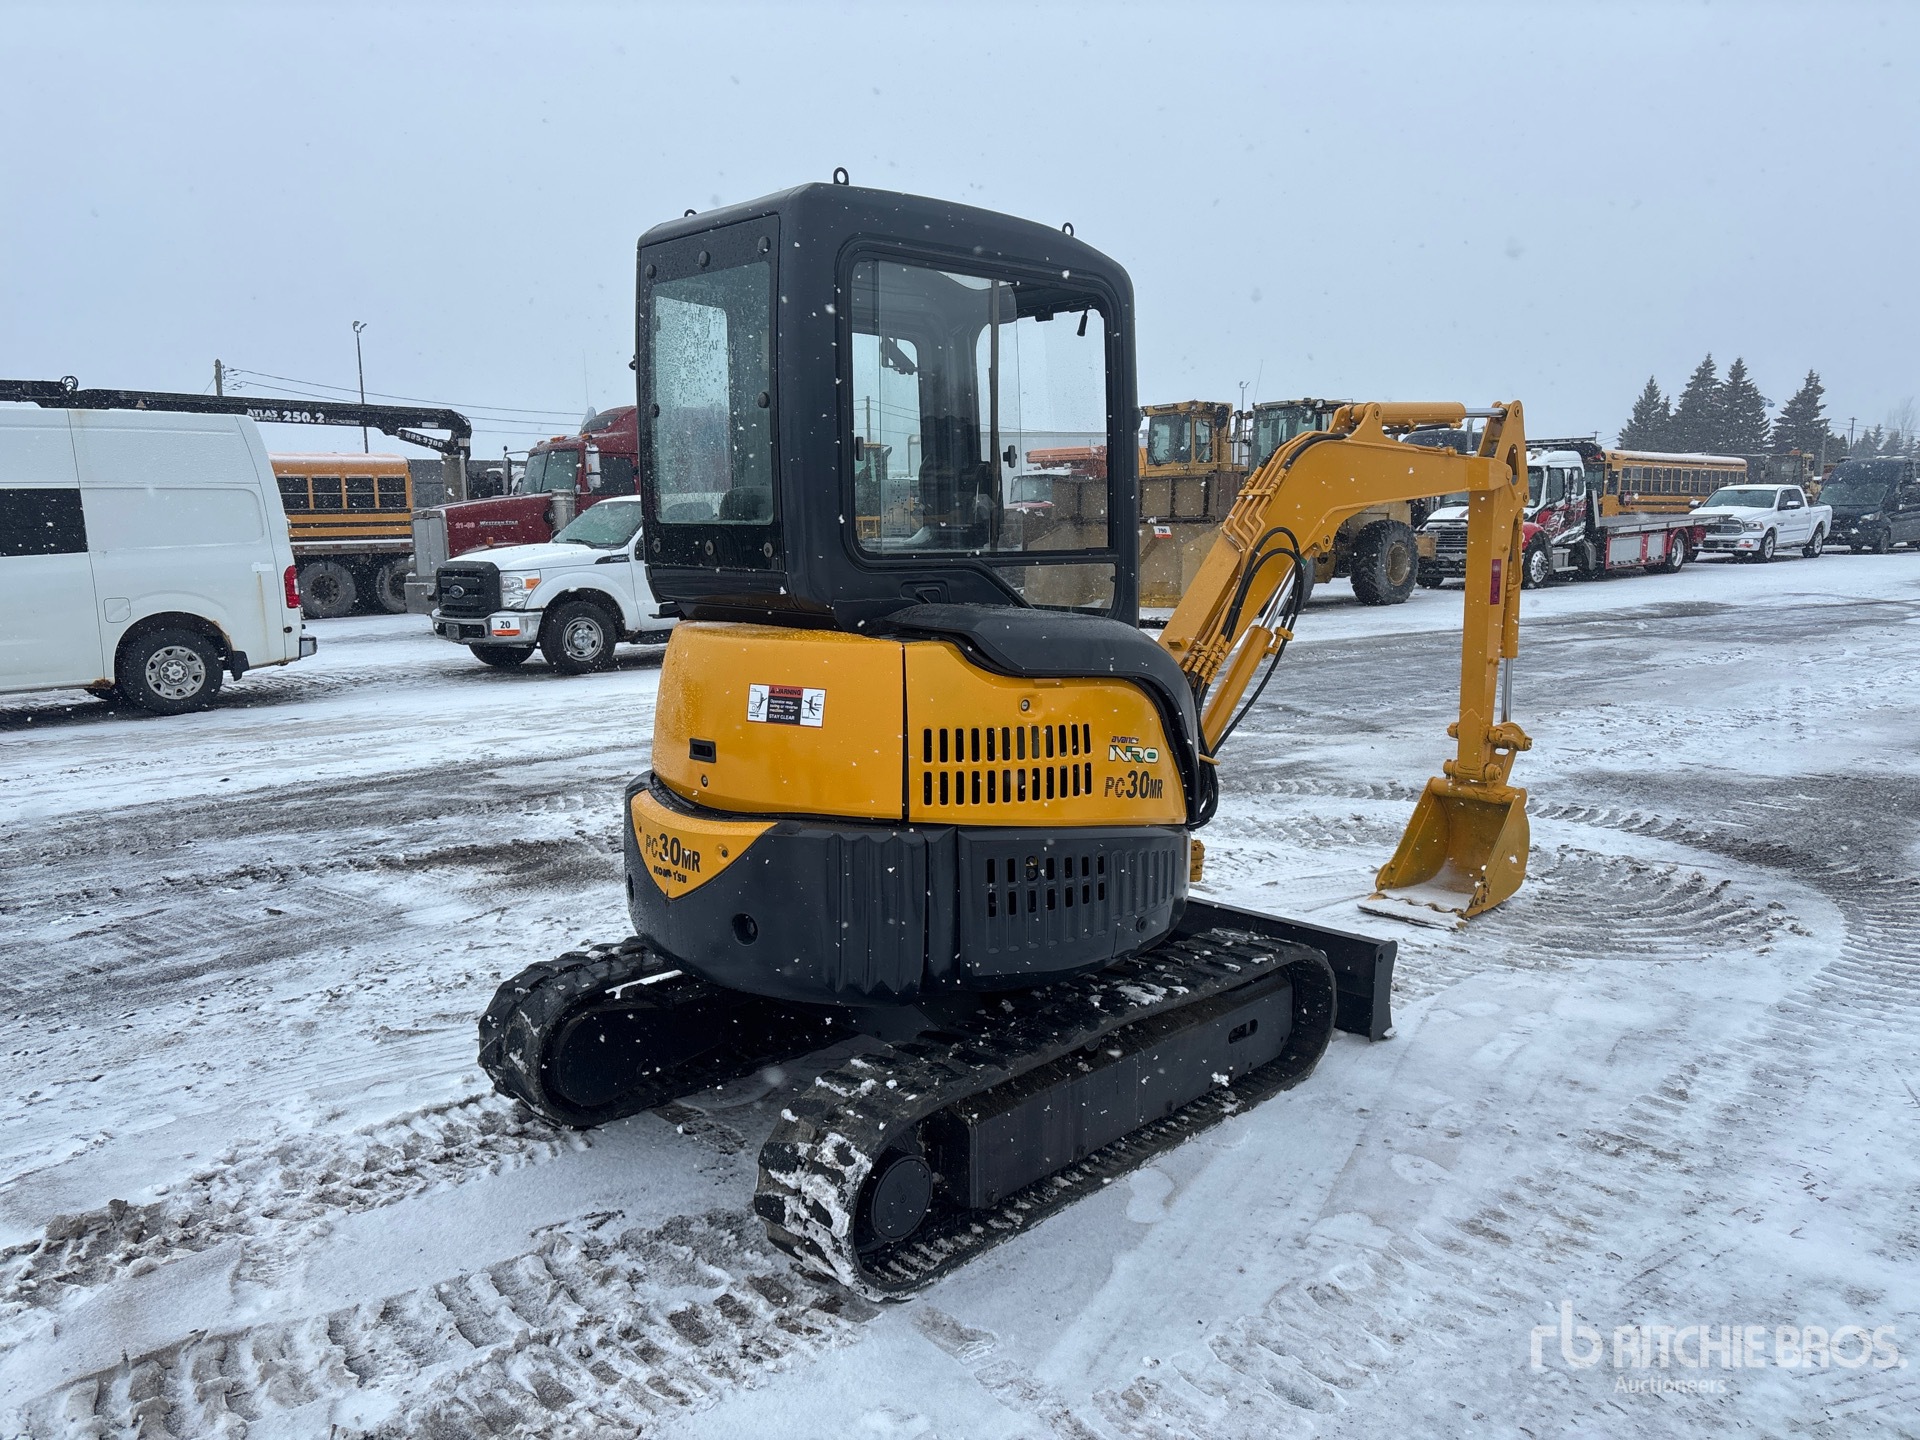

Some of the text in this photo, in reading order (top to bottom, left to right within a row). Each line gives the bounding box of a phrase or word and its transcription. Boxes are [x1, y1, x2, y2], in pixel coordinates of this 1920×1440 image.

[246, 407, 278, 418] ATLAS
[282, 410, 325, 424] 250.2
[500, 620, 511, 629] 20
[775, 687, 802, 696] WARNING
[1104, 770, 1163, 799] PC30MR
[646, 833, 701, 873] PC30MR
